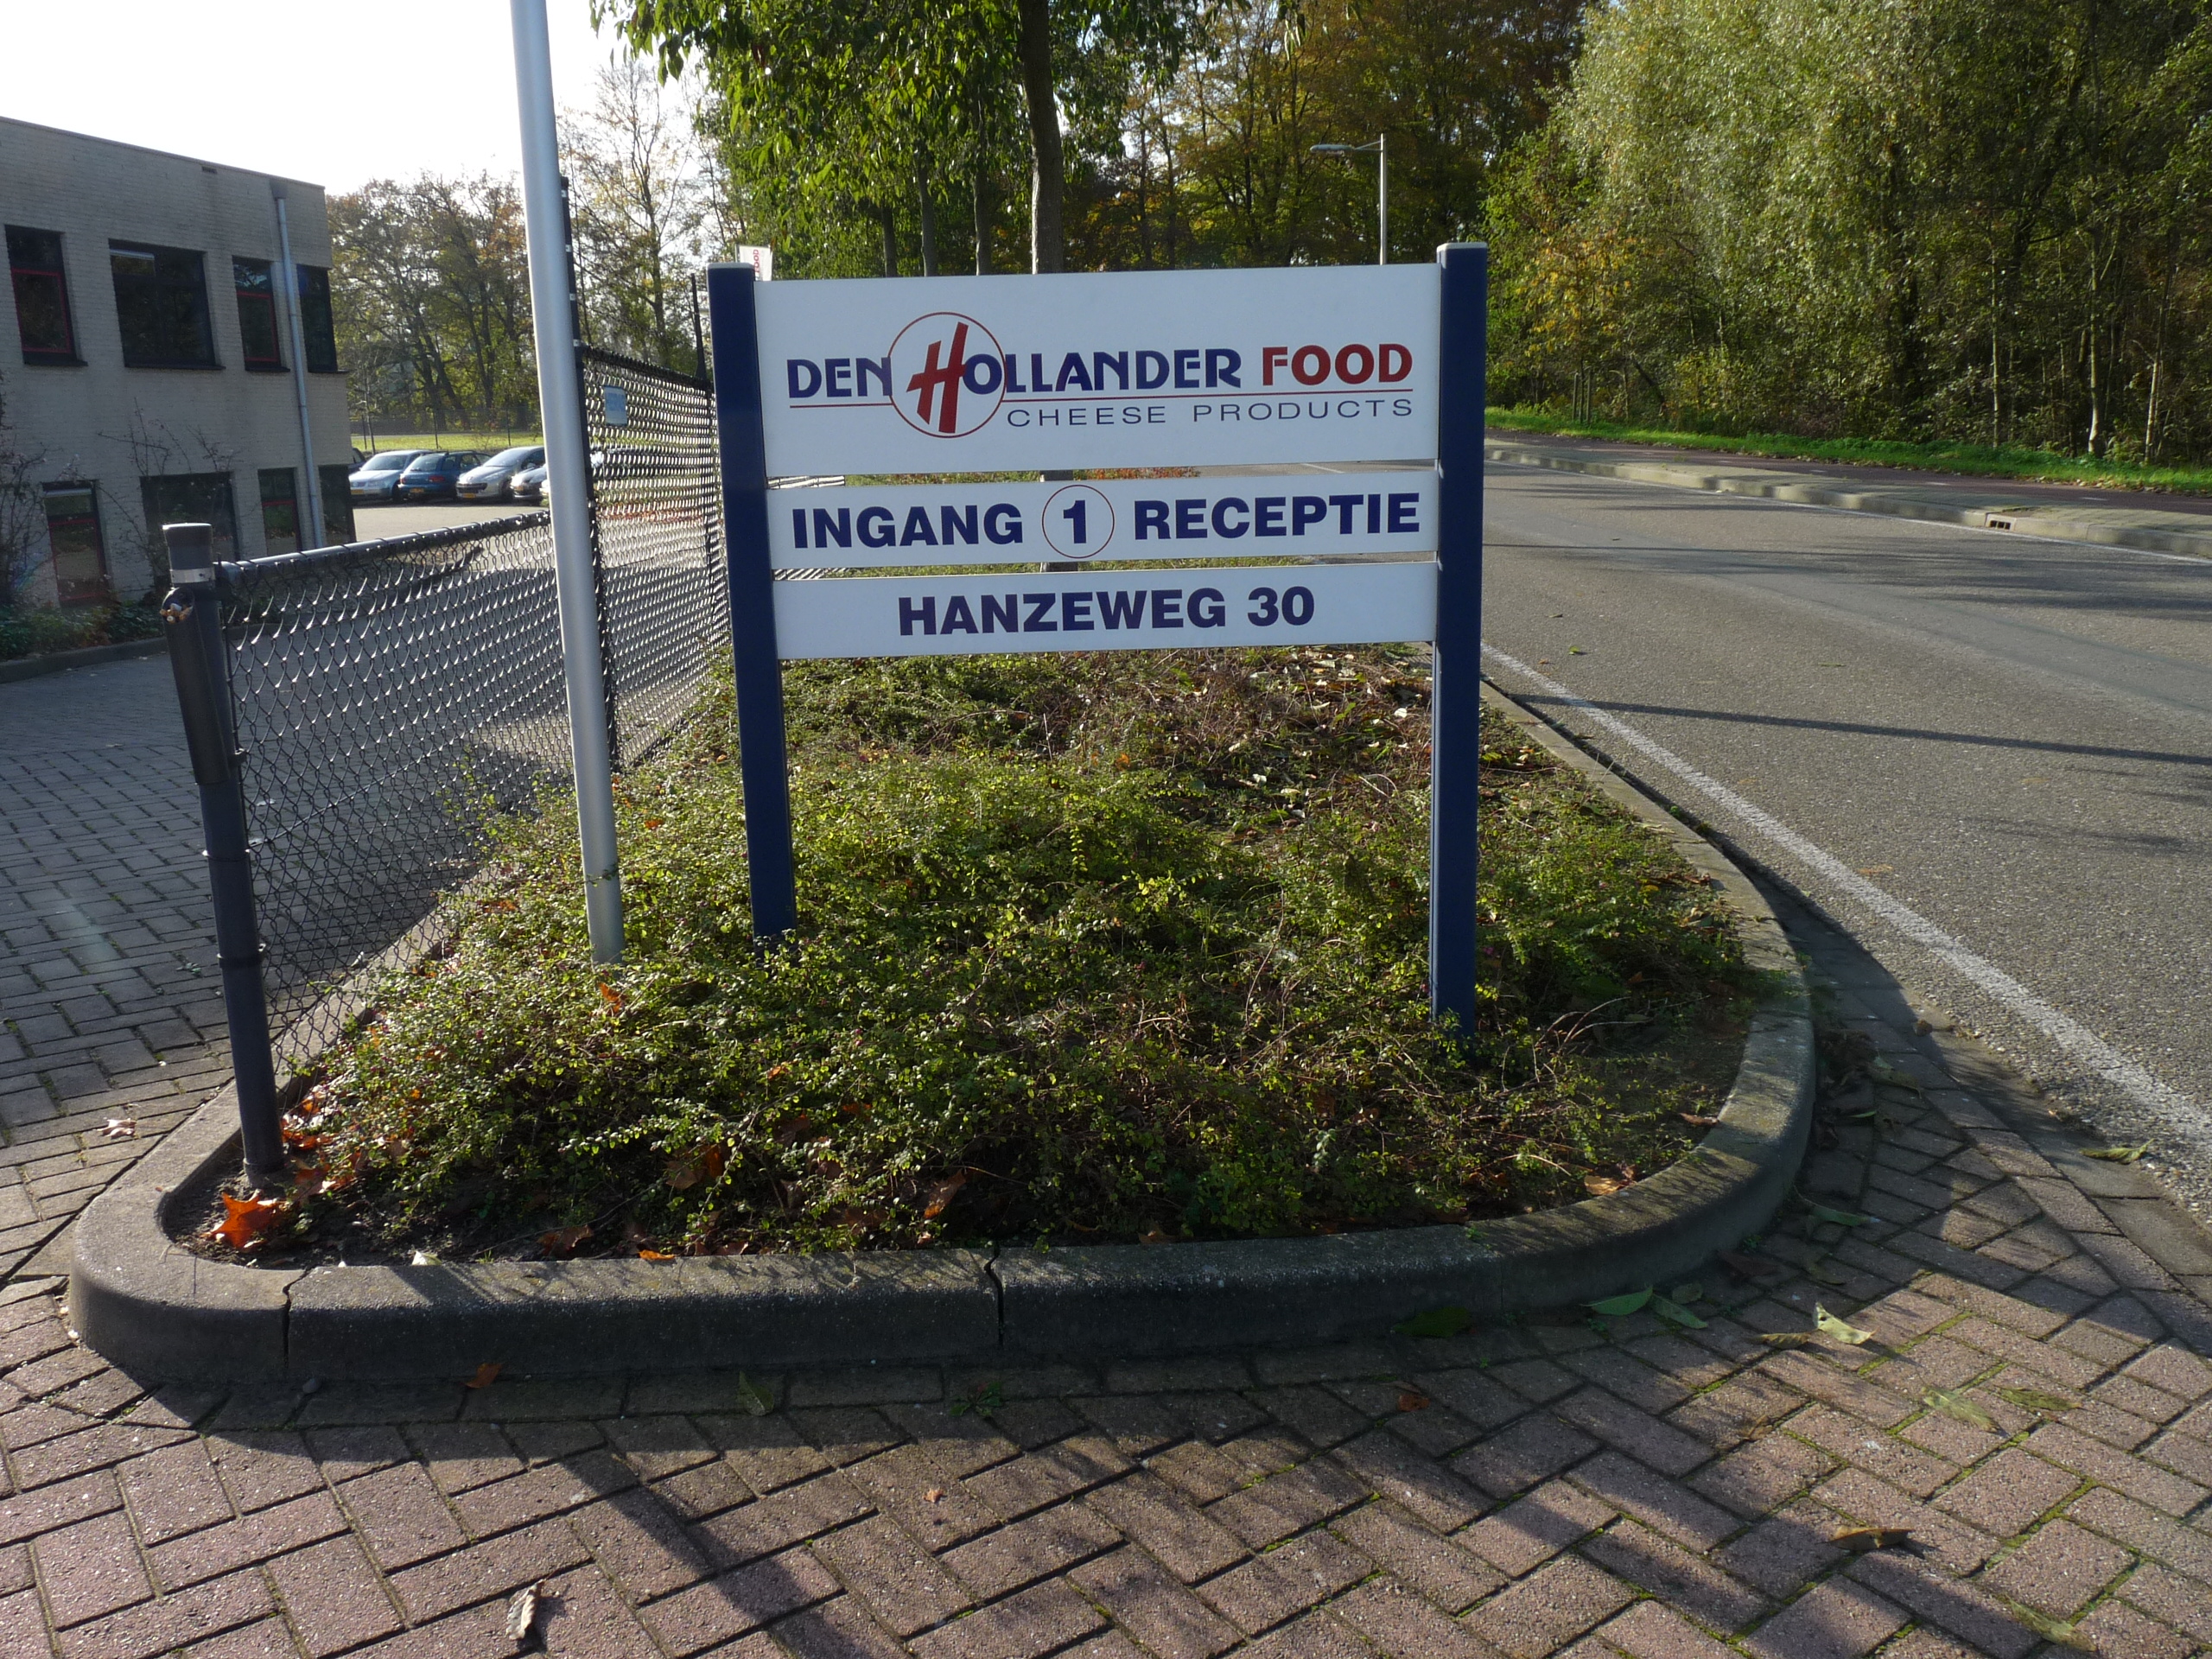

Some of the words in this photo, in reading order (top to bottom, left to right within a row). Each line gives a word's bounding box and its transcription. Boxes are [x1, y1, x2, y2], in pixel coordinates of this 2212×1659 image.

[786, 357, 893, 398] DEN
[906, 321, 1242, 434] HOLLANDER
[1262, 343, 1413, 386] FOOD
[1007, 405, 1166, 428] CHEESE
[1193, 398, 1412, 423] PRODUCTS
[791, 503, 1023, 550] INGANG
[1063, 499, 1087, 544] 1
[1135, 492, 1421, 541] RECEPTIE
[899, 587, 1226, 637] HANZEWEG
[1248, 585, 1315, 627] 30
